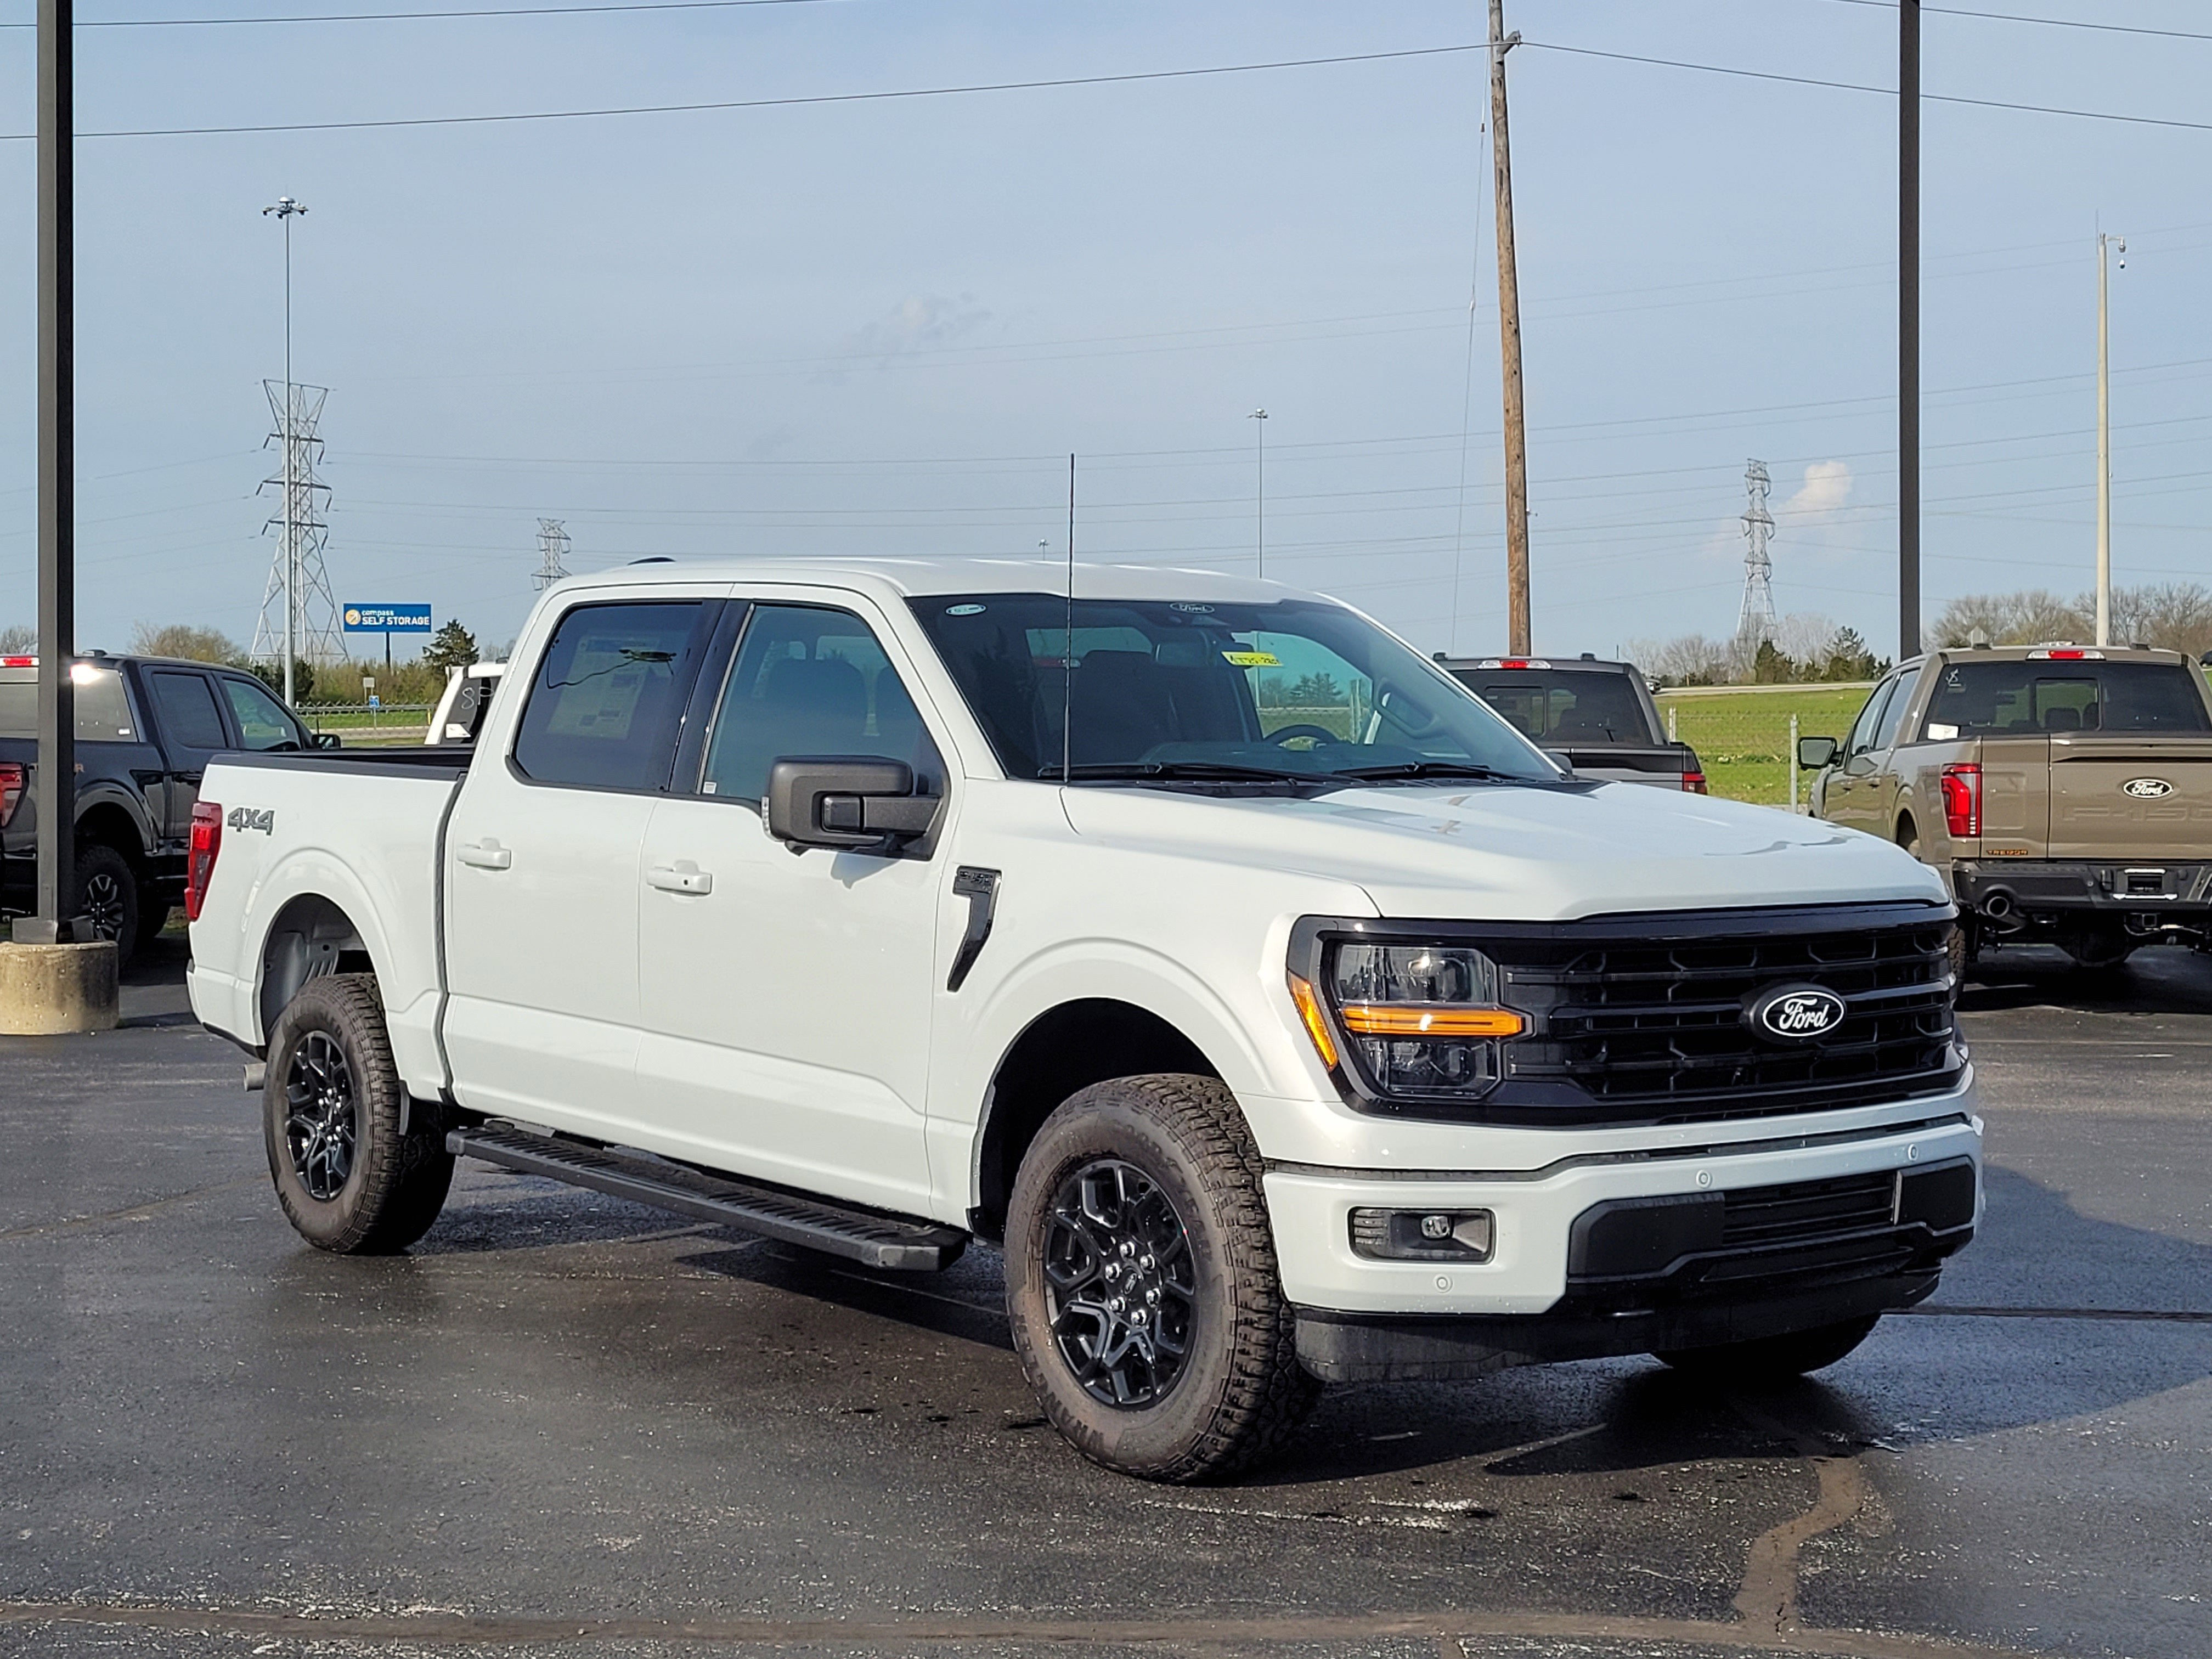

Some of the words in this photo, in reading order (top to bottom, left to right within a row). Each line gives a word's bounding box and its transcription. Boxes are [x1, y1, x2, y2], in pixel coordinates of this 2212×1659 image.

[362, 617, 385, 625] SELF
[387, 617, 430, 625] STORAGE
[2131, 781, 2164, 795] Ford
[1779, 998, 1830, 1029] Ford
